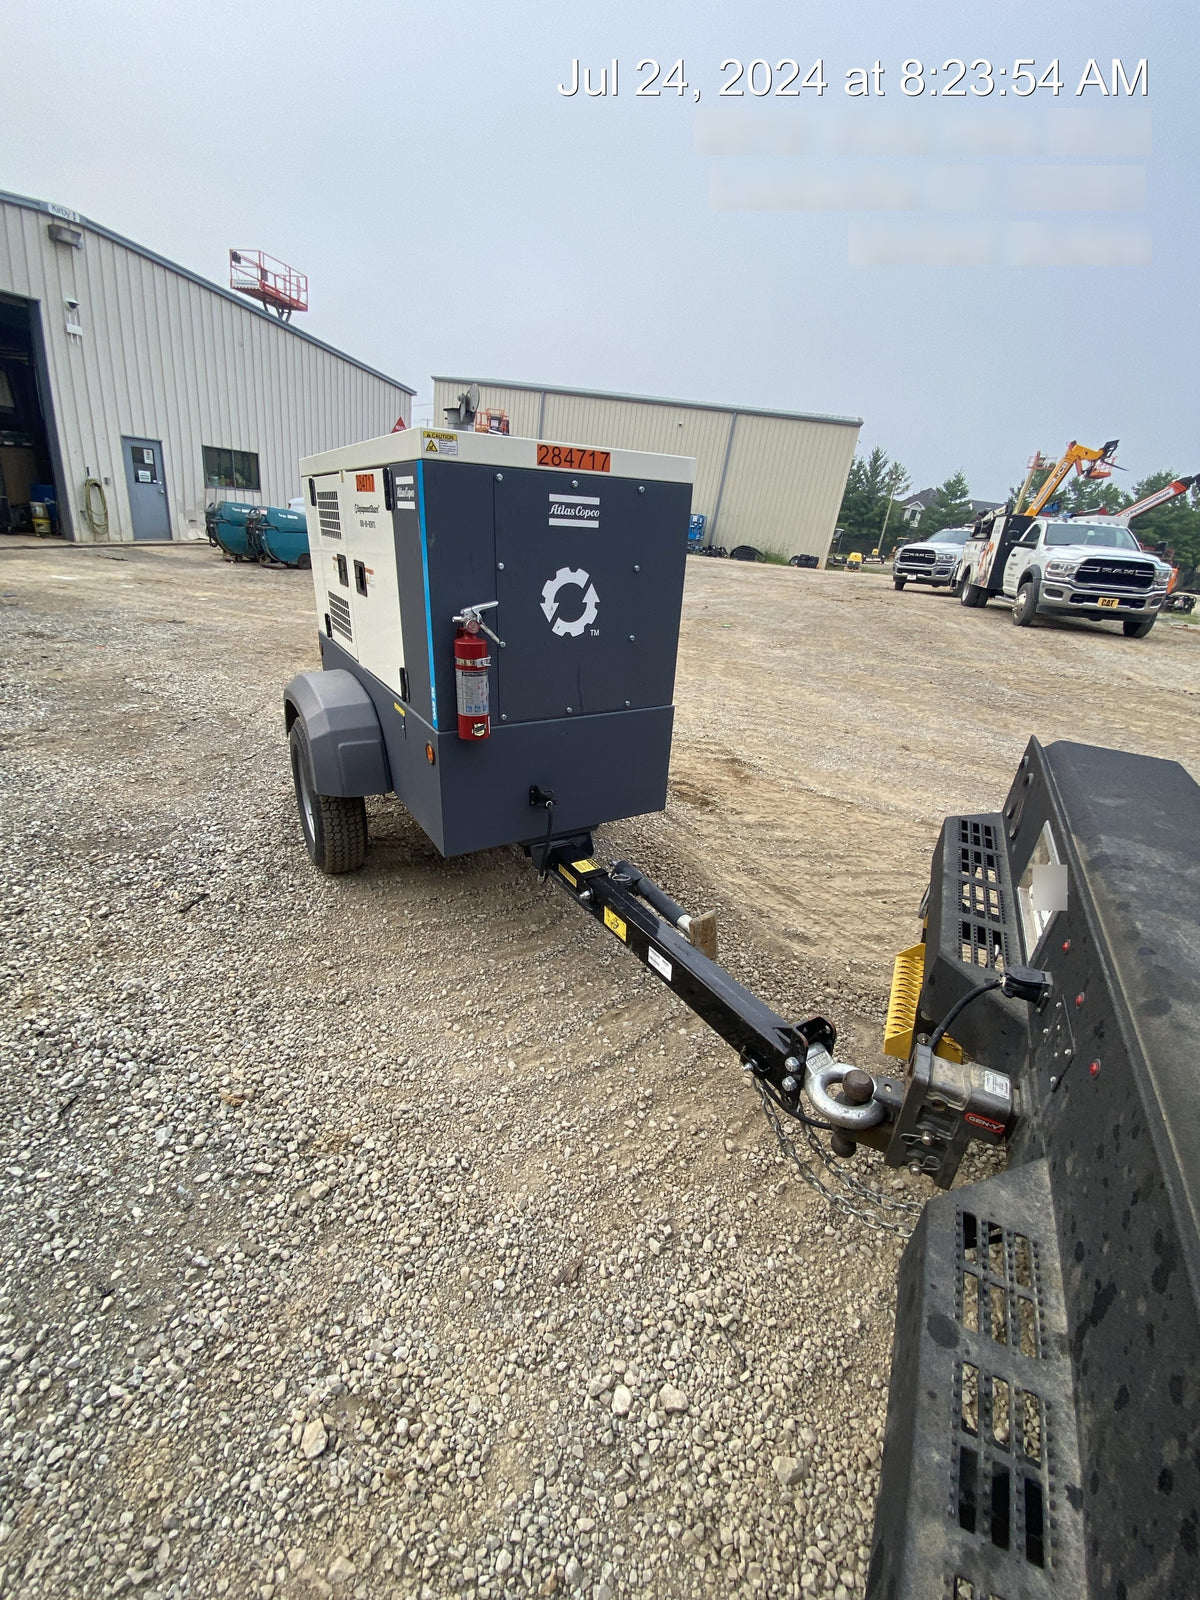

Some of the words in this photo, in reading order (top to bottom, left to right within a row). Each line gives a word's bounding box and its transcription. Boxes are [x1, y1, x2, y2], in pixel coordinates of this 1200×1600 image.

[539, 445, 610, 471] 284717
[1055, 461, 1069, 479] JCB
[1101, 567, 1135, 575] RAM
[1101, 599, 1115, 607] CAT
[590, 629, 600, 637] TM
[969, 1116, 1004, 1129] GEN-Y
